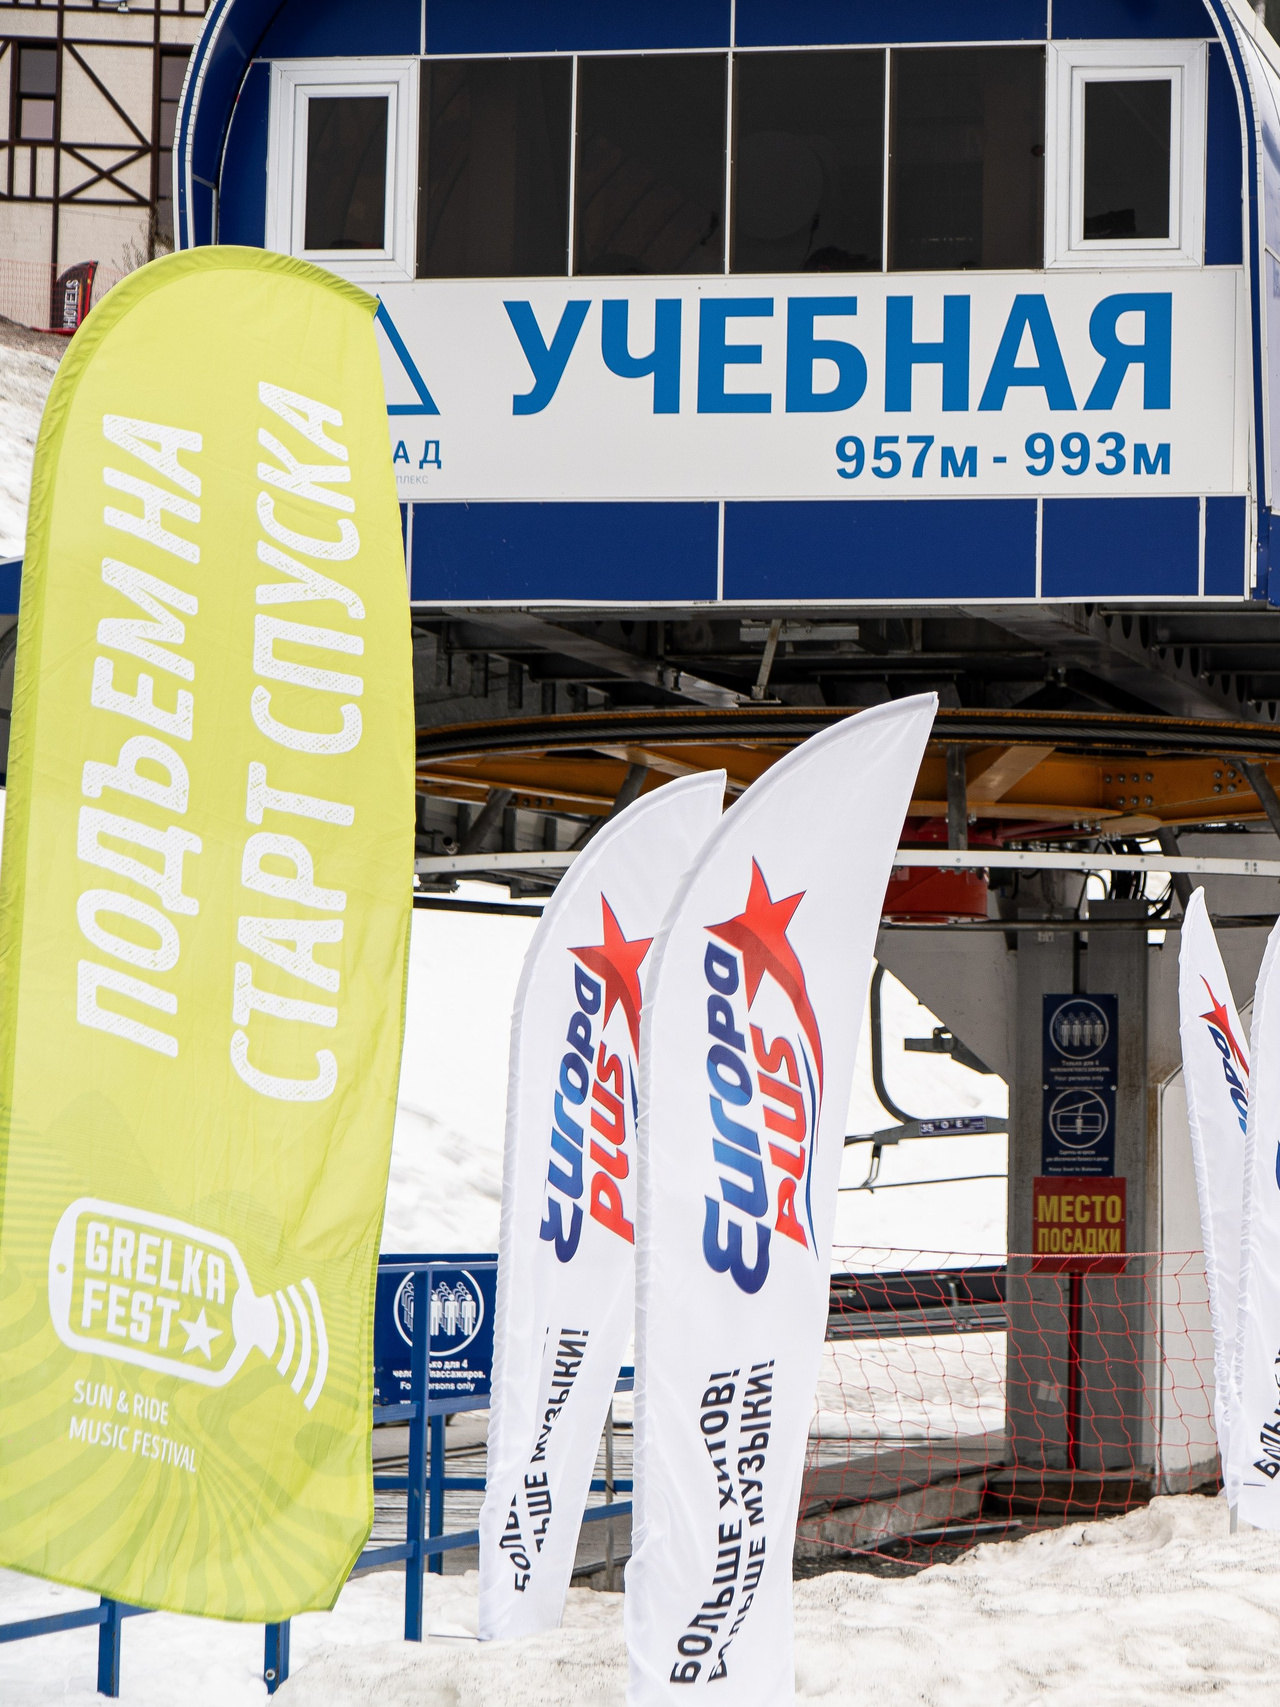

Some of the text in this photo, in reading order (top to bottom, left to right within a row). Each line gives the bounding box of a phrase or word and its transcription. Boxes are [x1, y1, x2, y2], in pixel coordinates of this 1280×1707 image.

[502, 292, 1173, 415] УЧЕБНАЯ
[835, 431, 1173, 479] 957м - 993м
[77, 414, 203, 1058] ПОДЪЕМ НА
[230, 381, 366, 1102] СТАРТ СПУСКА
[1037, 1195, 1122, 1224] МЕСТО
[1037, 1226, 1121, 1255] ПОСАДКИ
[85, 1221, 226, 1306] GRELKA
[81, 1281, 181, 1349] FEST
[456, 1382, 475, 1391] only
[461, 1359, 468, 1369] 4
[73, 1380, 169, 1426] SUN & RIDE
[69, 1416, 197, 1473] MUSIC FESTIVAL
[737, 1359, 775, 1528] МУЗЫКИ!
[669, 1368, 742, 1684] БОЛЬШЕ ХИТОВ!
